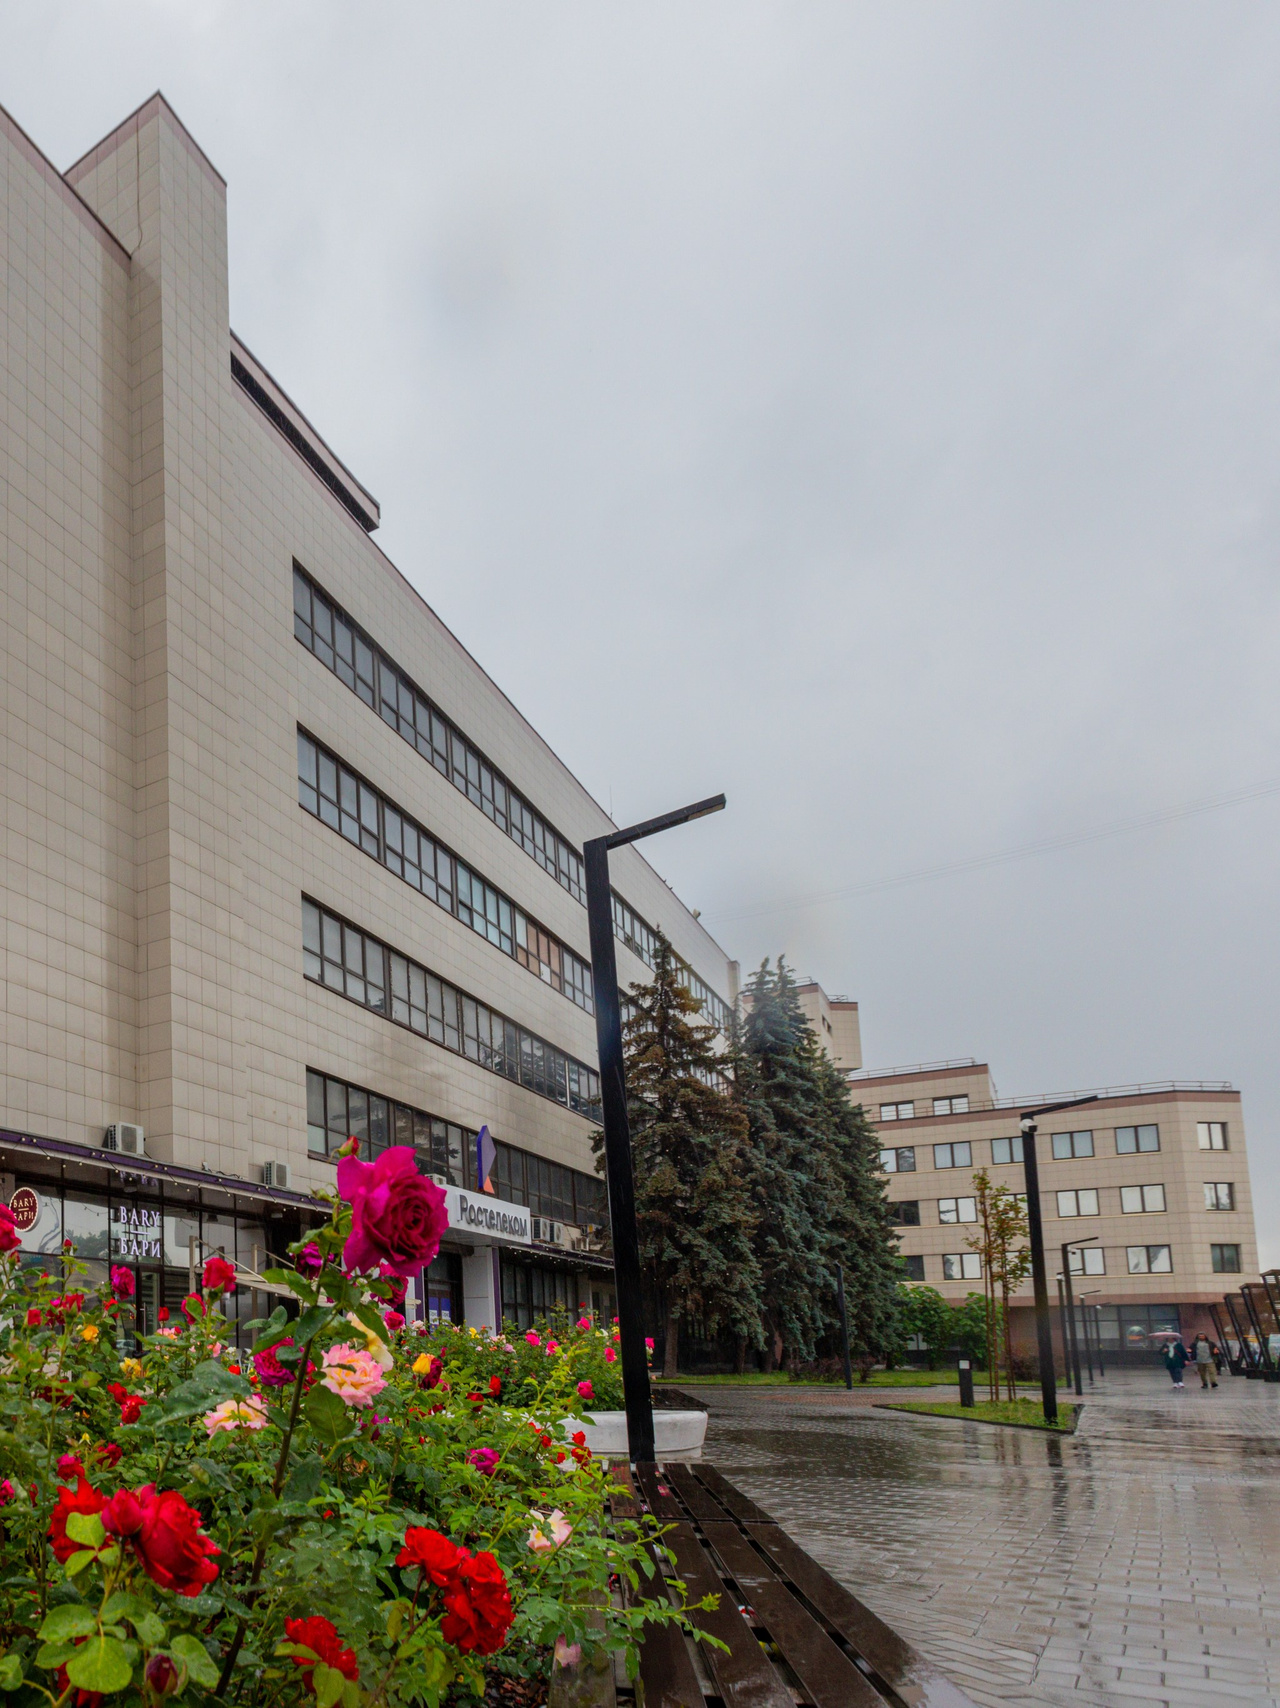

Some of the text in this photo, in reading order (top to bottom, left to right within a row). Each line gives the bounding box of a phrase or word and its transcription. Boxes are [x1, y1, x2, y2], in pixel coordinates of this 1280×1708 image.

[13, 1197, 34, 1208] BARY
[120, 1206, 160, 1228] BARY
[458, 1194, 528, 1238] Ростелеком
[120, 1237, 161, 1258] БАРИ
